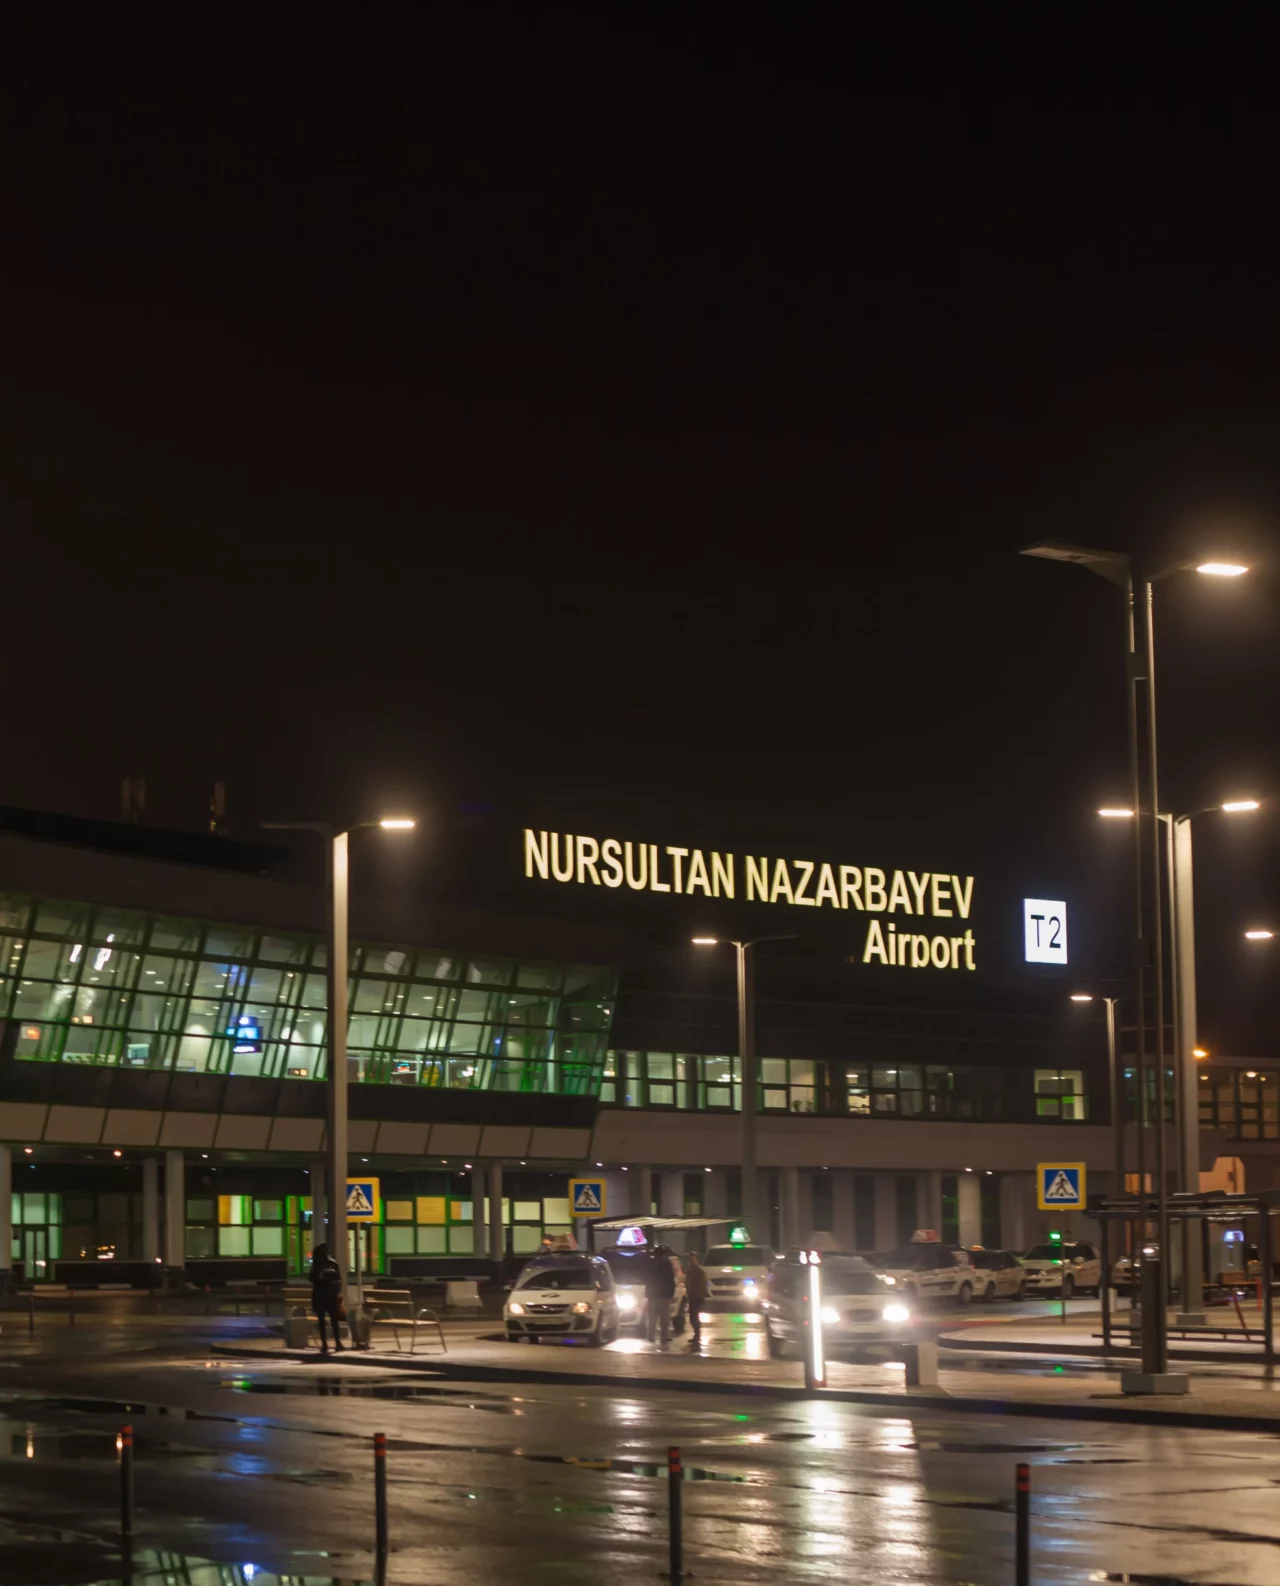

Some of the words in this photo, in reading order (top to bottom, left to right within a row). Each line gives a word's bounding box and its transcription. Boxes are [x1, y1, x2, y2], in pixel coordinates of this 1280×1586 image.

[524, 828, 735, 899] NURSULTAN
[745, 855, 975, 919] NAZARBAYEV
[862, 919, 976, 971] Airport
[1030, 914, 1061, 949] T2
